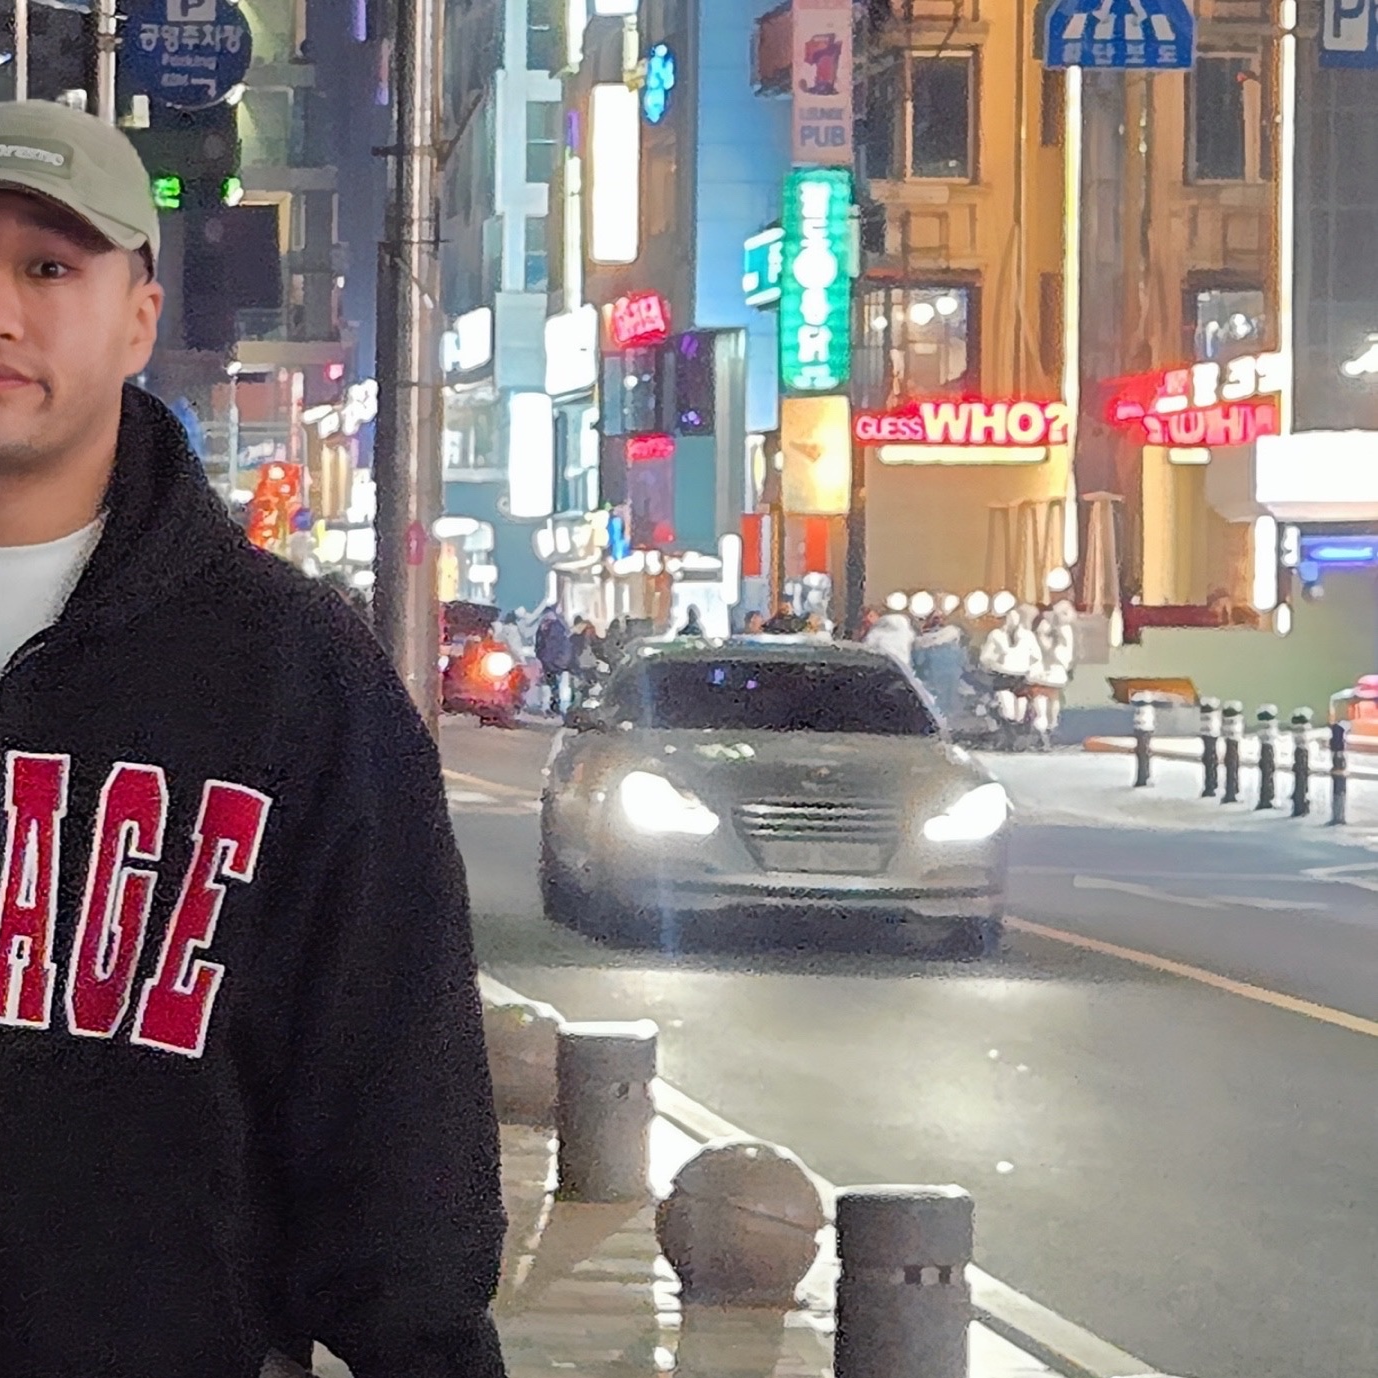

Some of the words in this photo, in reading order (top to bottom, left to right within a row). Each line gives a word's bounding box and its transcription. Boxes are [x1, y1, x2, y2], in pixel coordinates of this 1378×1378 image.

[1333, 0, 1365, 38] P
[139, 23, 243, 53] 공영주차장
[800, 125, 846, 147] PUB
[856, 415, 922, 441] GUESS
[920, 401, 1069, 444] WHO?
